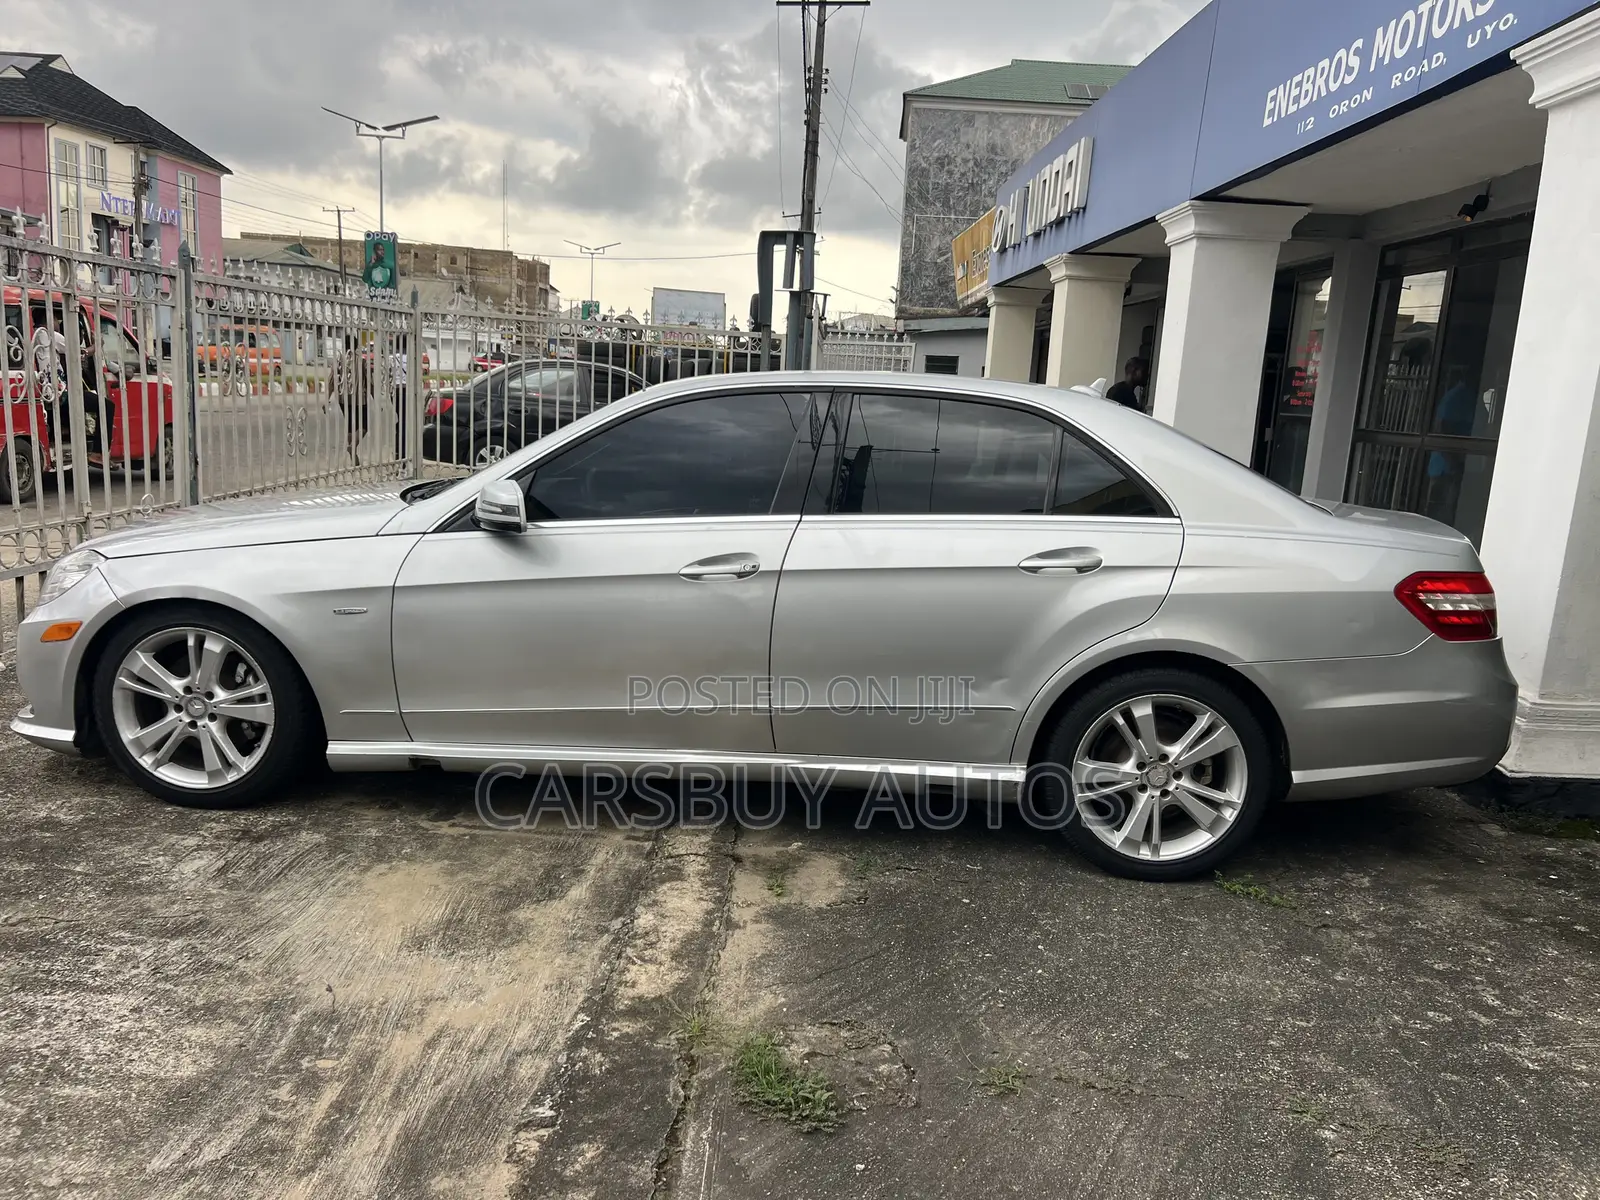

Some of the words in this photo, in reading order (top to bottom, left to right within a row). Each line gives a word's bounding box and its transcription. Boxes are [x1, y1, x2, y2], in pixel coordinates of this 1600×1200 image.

[1262, 38, 1363, 128] ENEBROS
[1296, 116, 1314, 135] 112
[1329, 86, 1373, 119] ORON
[1390, 51, 1447, 89] ROAD,
[365, 231, 396, 243] OPay
